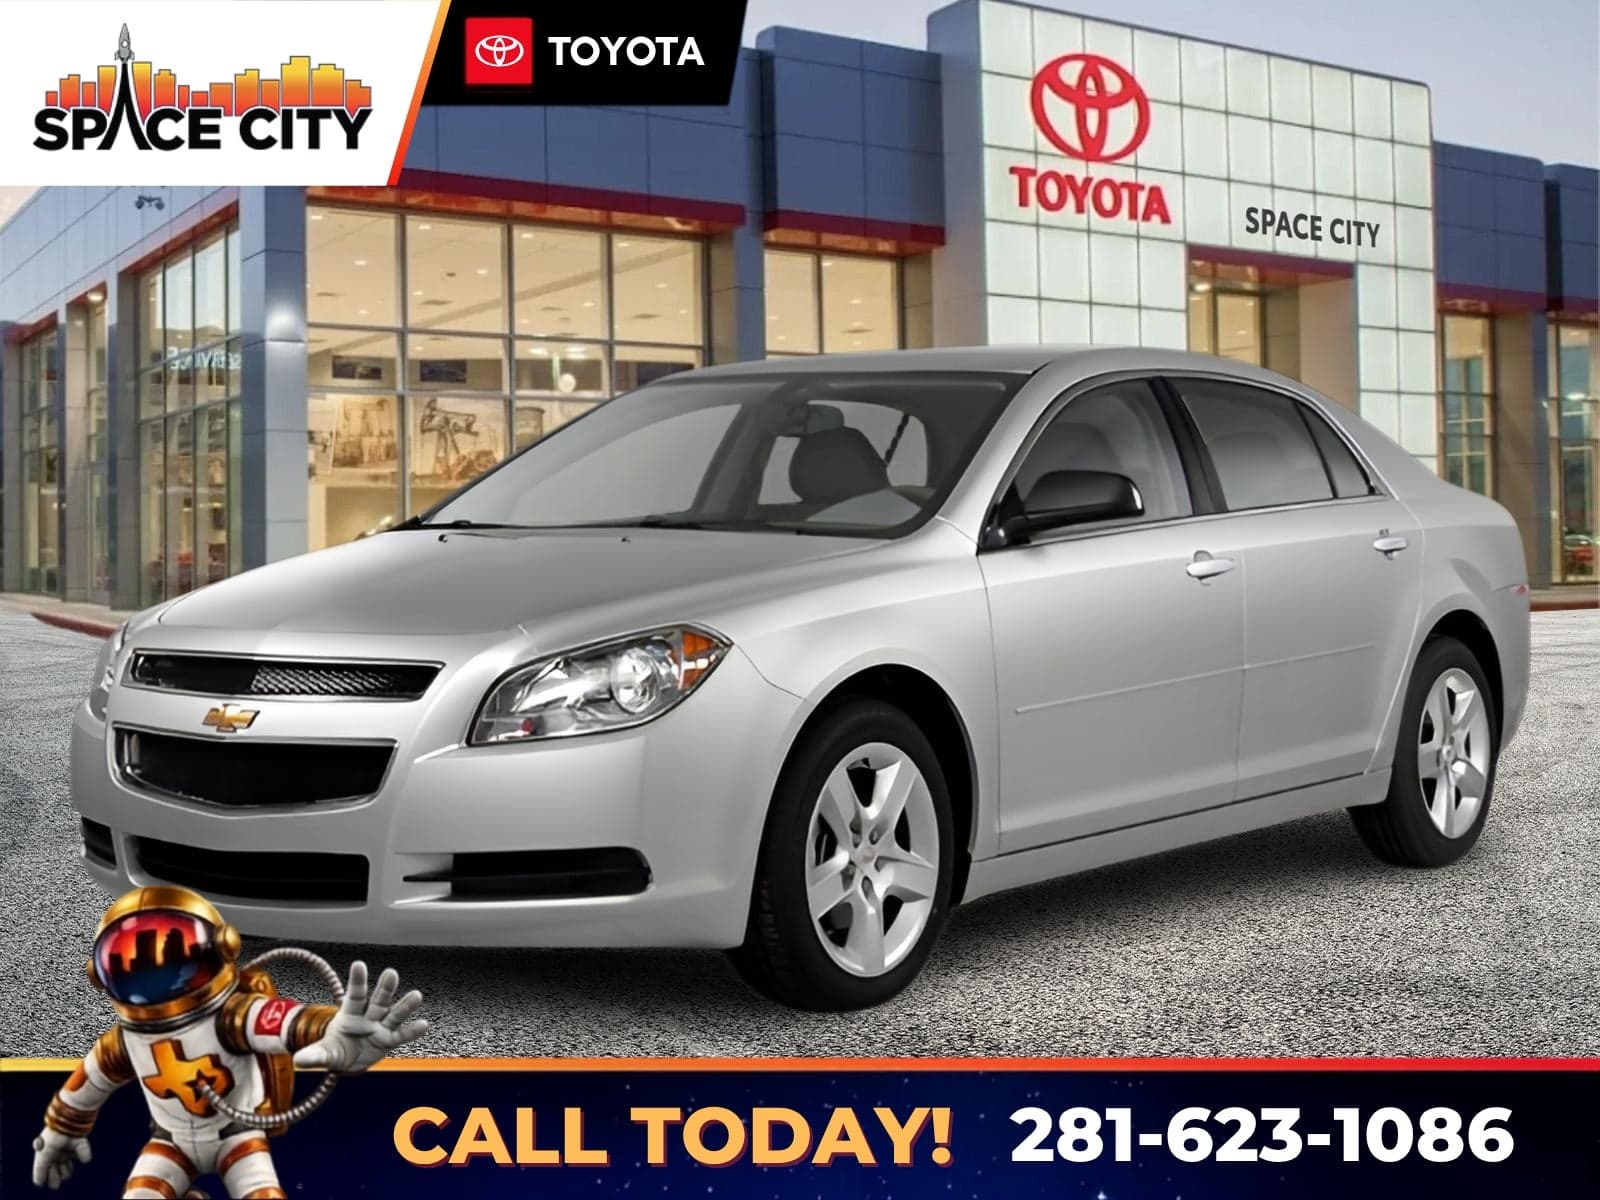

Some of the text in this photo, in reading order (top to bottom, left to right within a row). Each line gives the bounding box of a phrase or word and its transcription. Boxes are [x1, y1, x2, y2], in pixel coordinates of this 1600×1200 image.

[1009, 166, 1171, 224] TOYOTA
[1245, 206, 1381, 248] SPACE CITY
